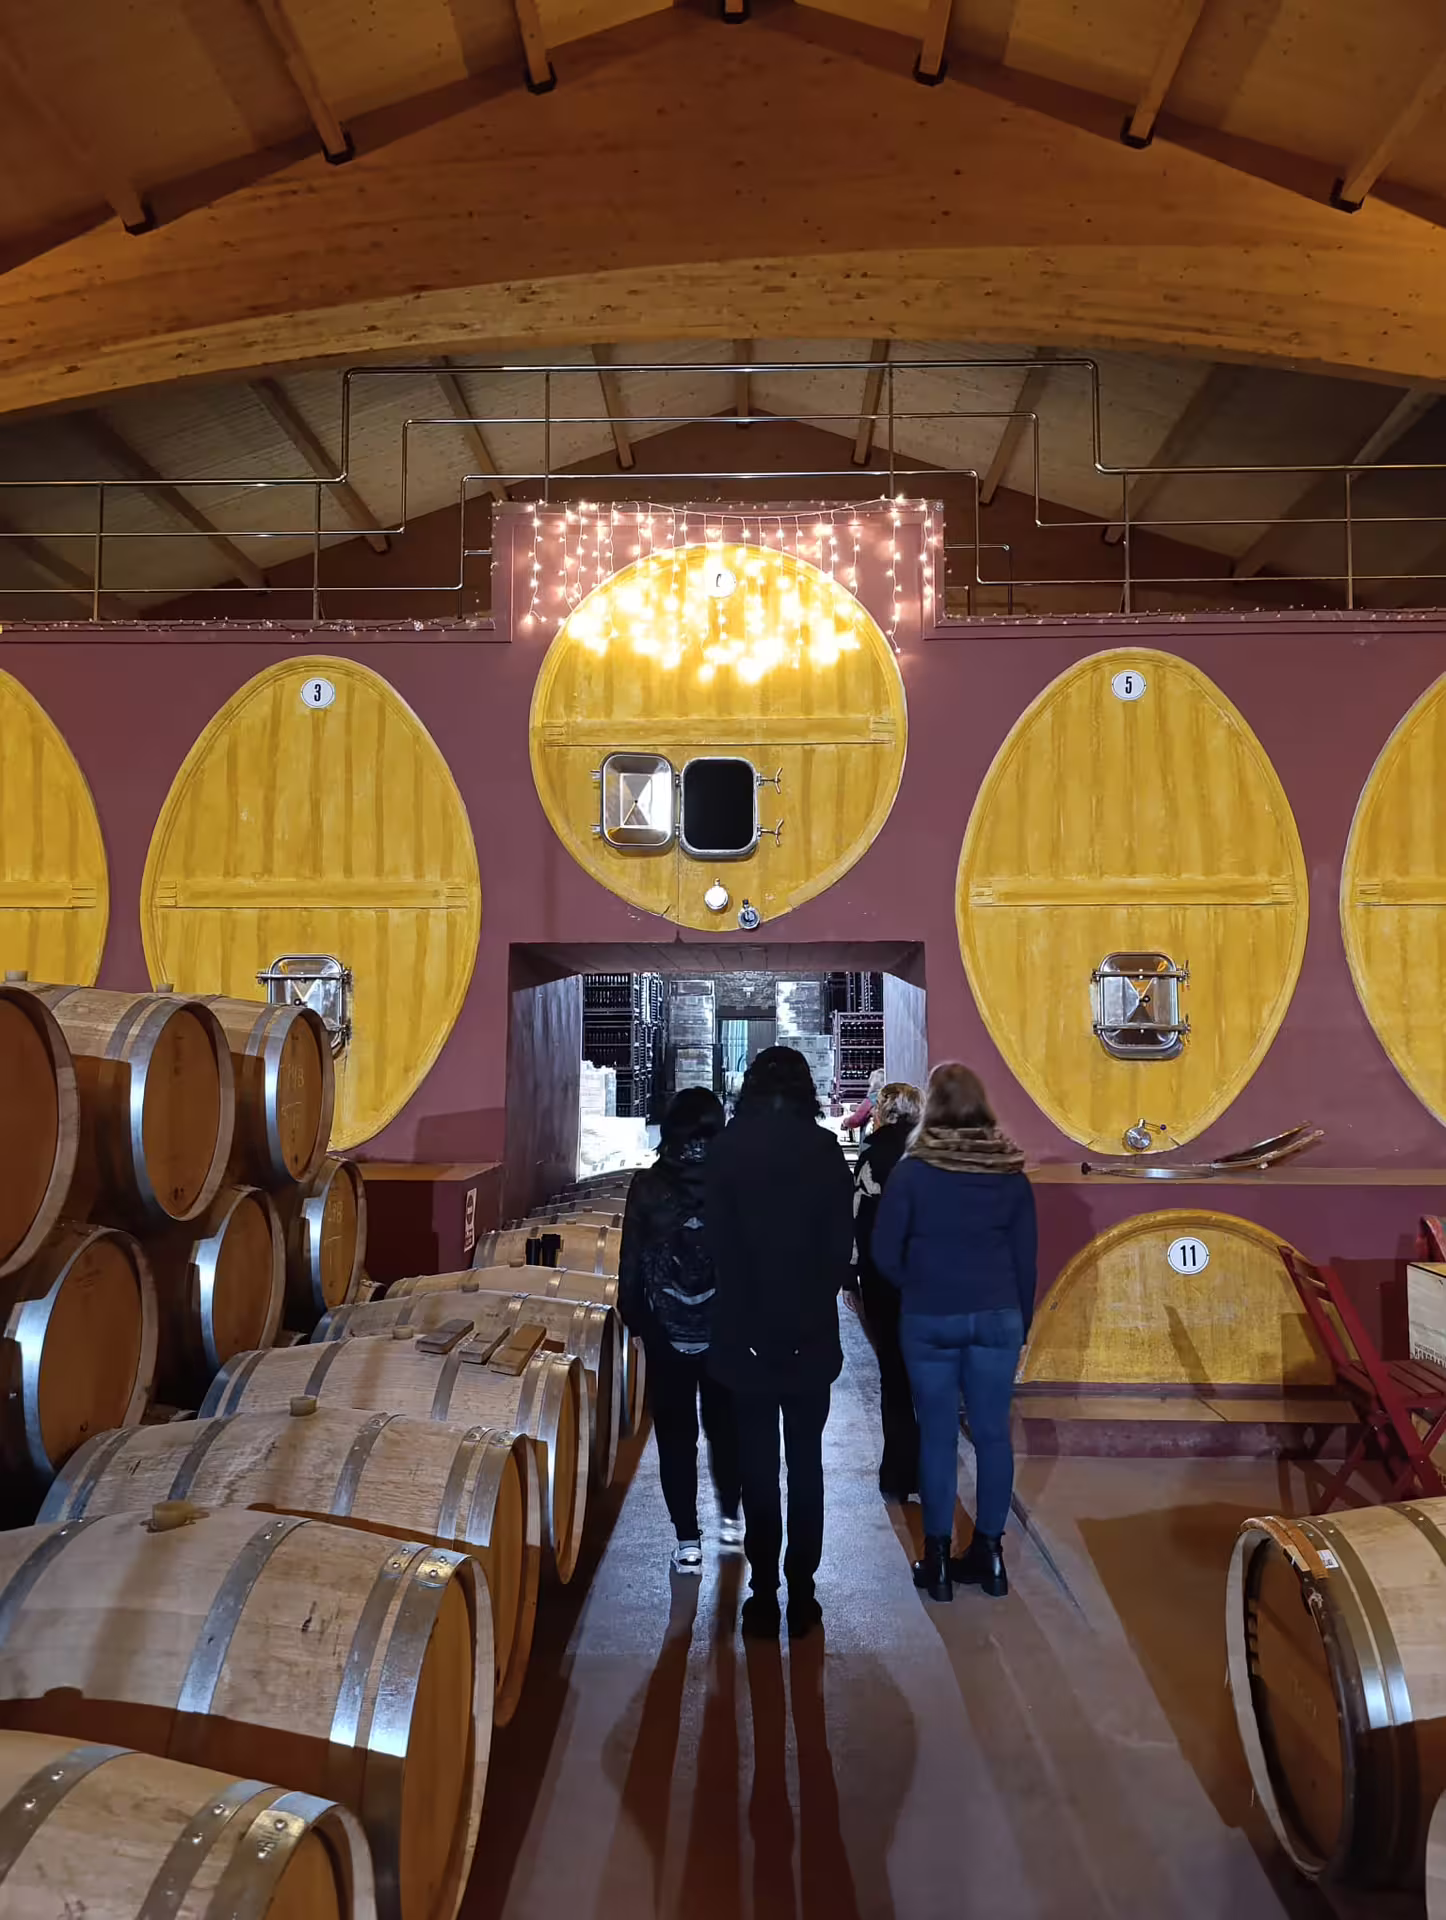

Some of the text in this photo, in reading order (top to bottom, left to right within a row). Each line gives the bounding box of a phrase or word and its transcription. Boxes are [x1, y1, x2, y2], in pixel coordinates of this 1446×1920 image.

[314, 683, 321, 702] 3
[1125, 676, 1132, 694] 5
[1180, 1244, 1196, 1267] 11
